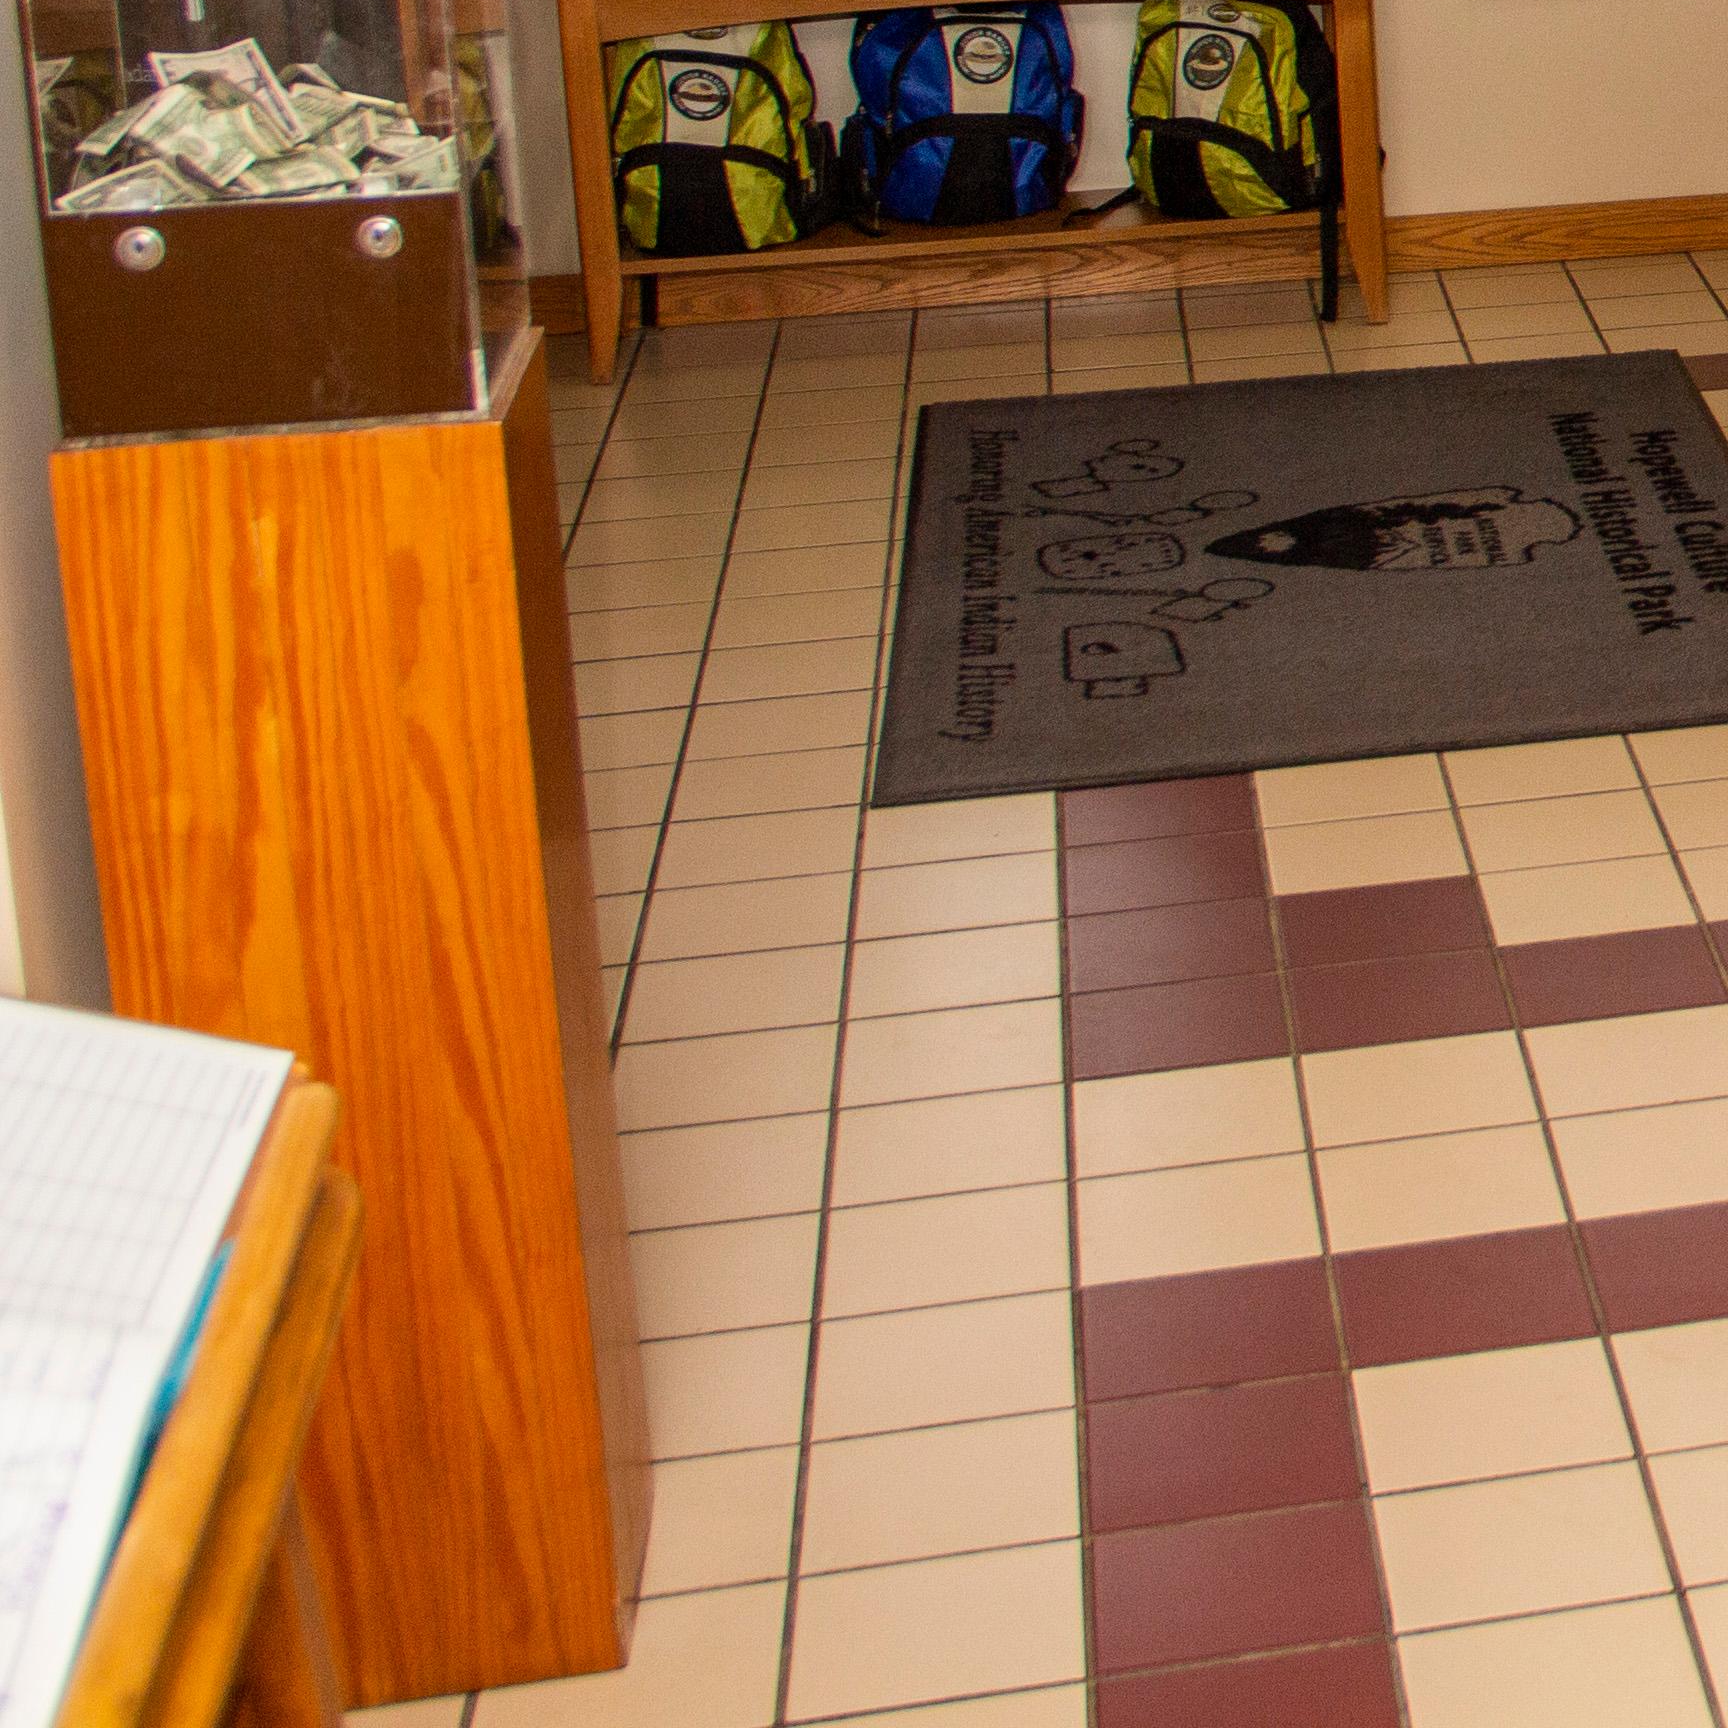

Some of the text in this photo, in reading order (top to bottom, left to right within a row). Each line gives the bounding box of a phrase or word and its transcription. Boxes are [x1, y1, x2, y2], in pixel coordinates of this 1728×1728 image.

[1628, 429, 1718, 514] Hopewell
[963, 508, 1015, 589] American
[1548, 412, 1695, 636] National Historical Park
[960, 593, 1017, 658] Indian
[938, 662, 1016, 741] History
